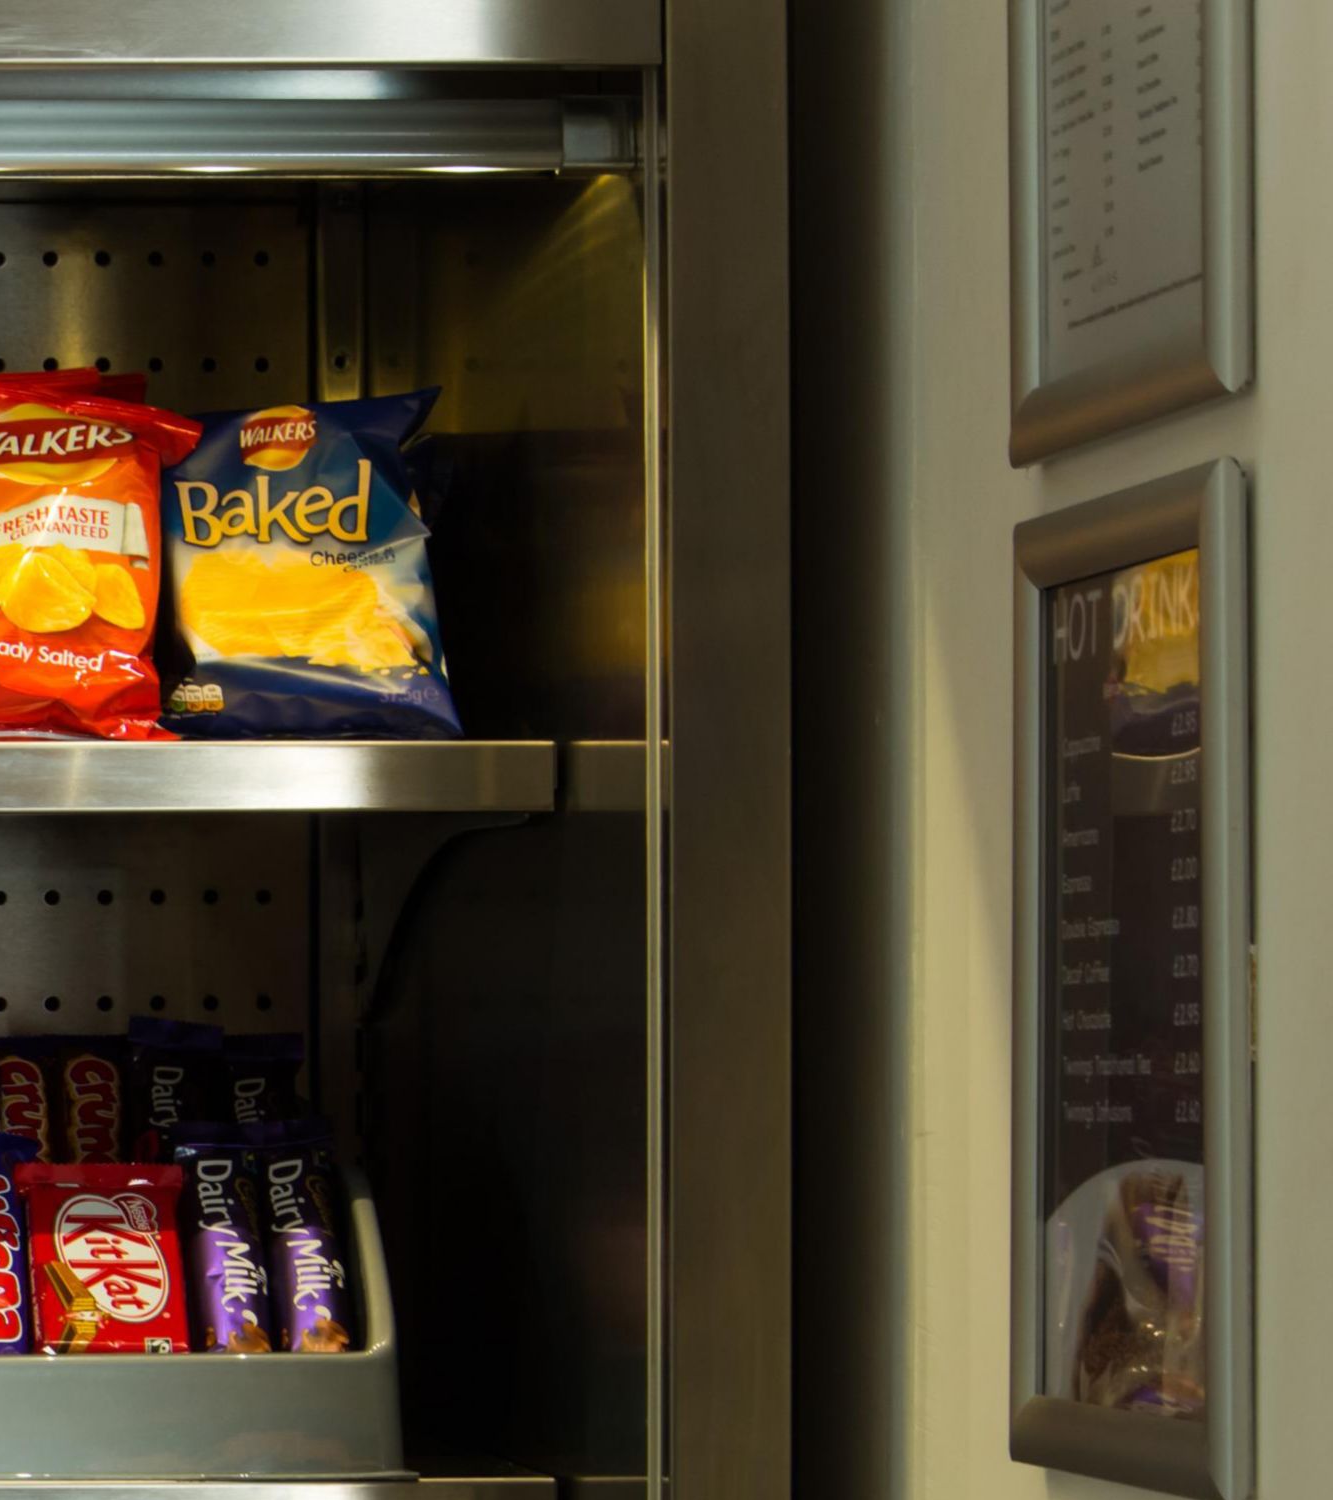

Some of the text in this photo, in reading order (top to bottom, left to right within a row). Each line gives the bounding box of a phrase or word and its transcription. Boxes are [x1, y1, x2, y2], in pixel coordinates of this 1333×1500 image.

[239, 419, 317, 448] WALKERS
[54, 507, 111, 526] TASTE
[175, 459, 370, 546] Baked
[1052, 564, 1198, 664] HOT DRINK
[37, 646, 104, 672] Salted
[149, 1065, 184, 1128] Dairy
[60, 1213, 165, 1312] KitKat
[197, 1159, 258, 1314] Dairy Milk
[267, 1158, 333, 1313] Dairy Milk
